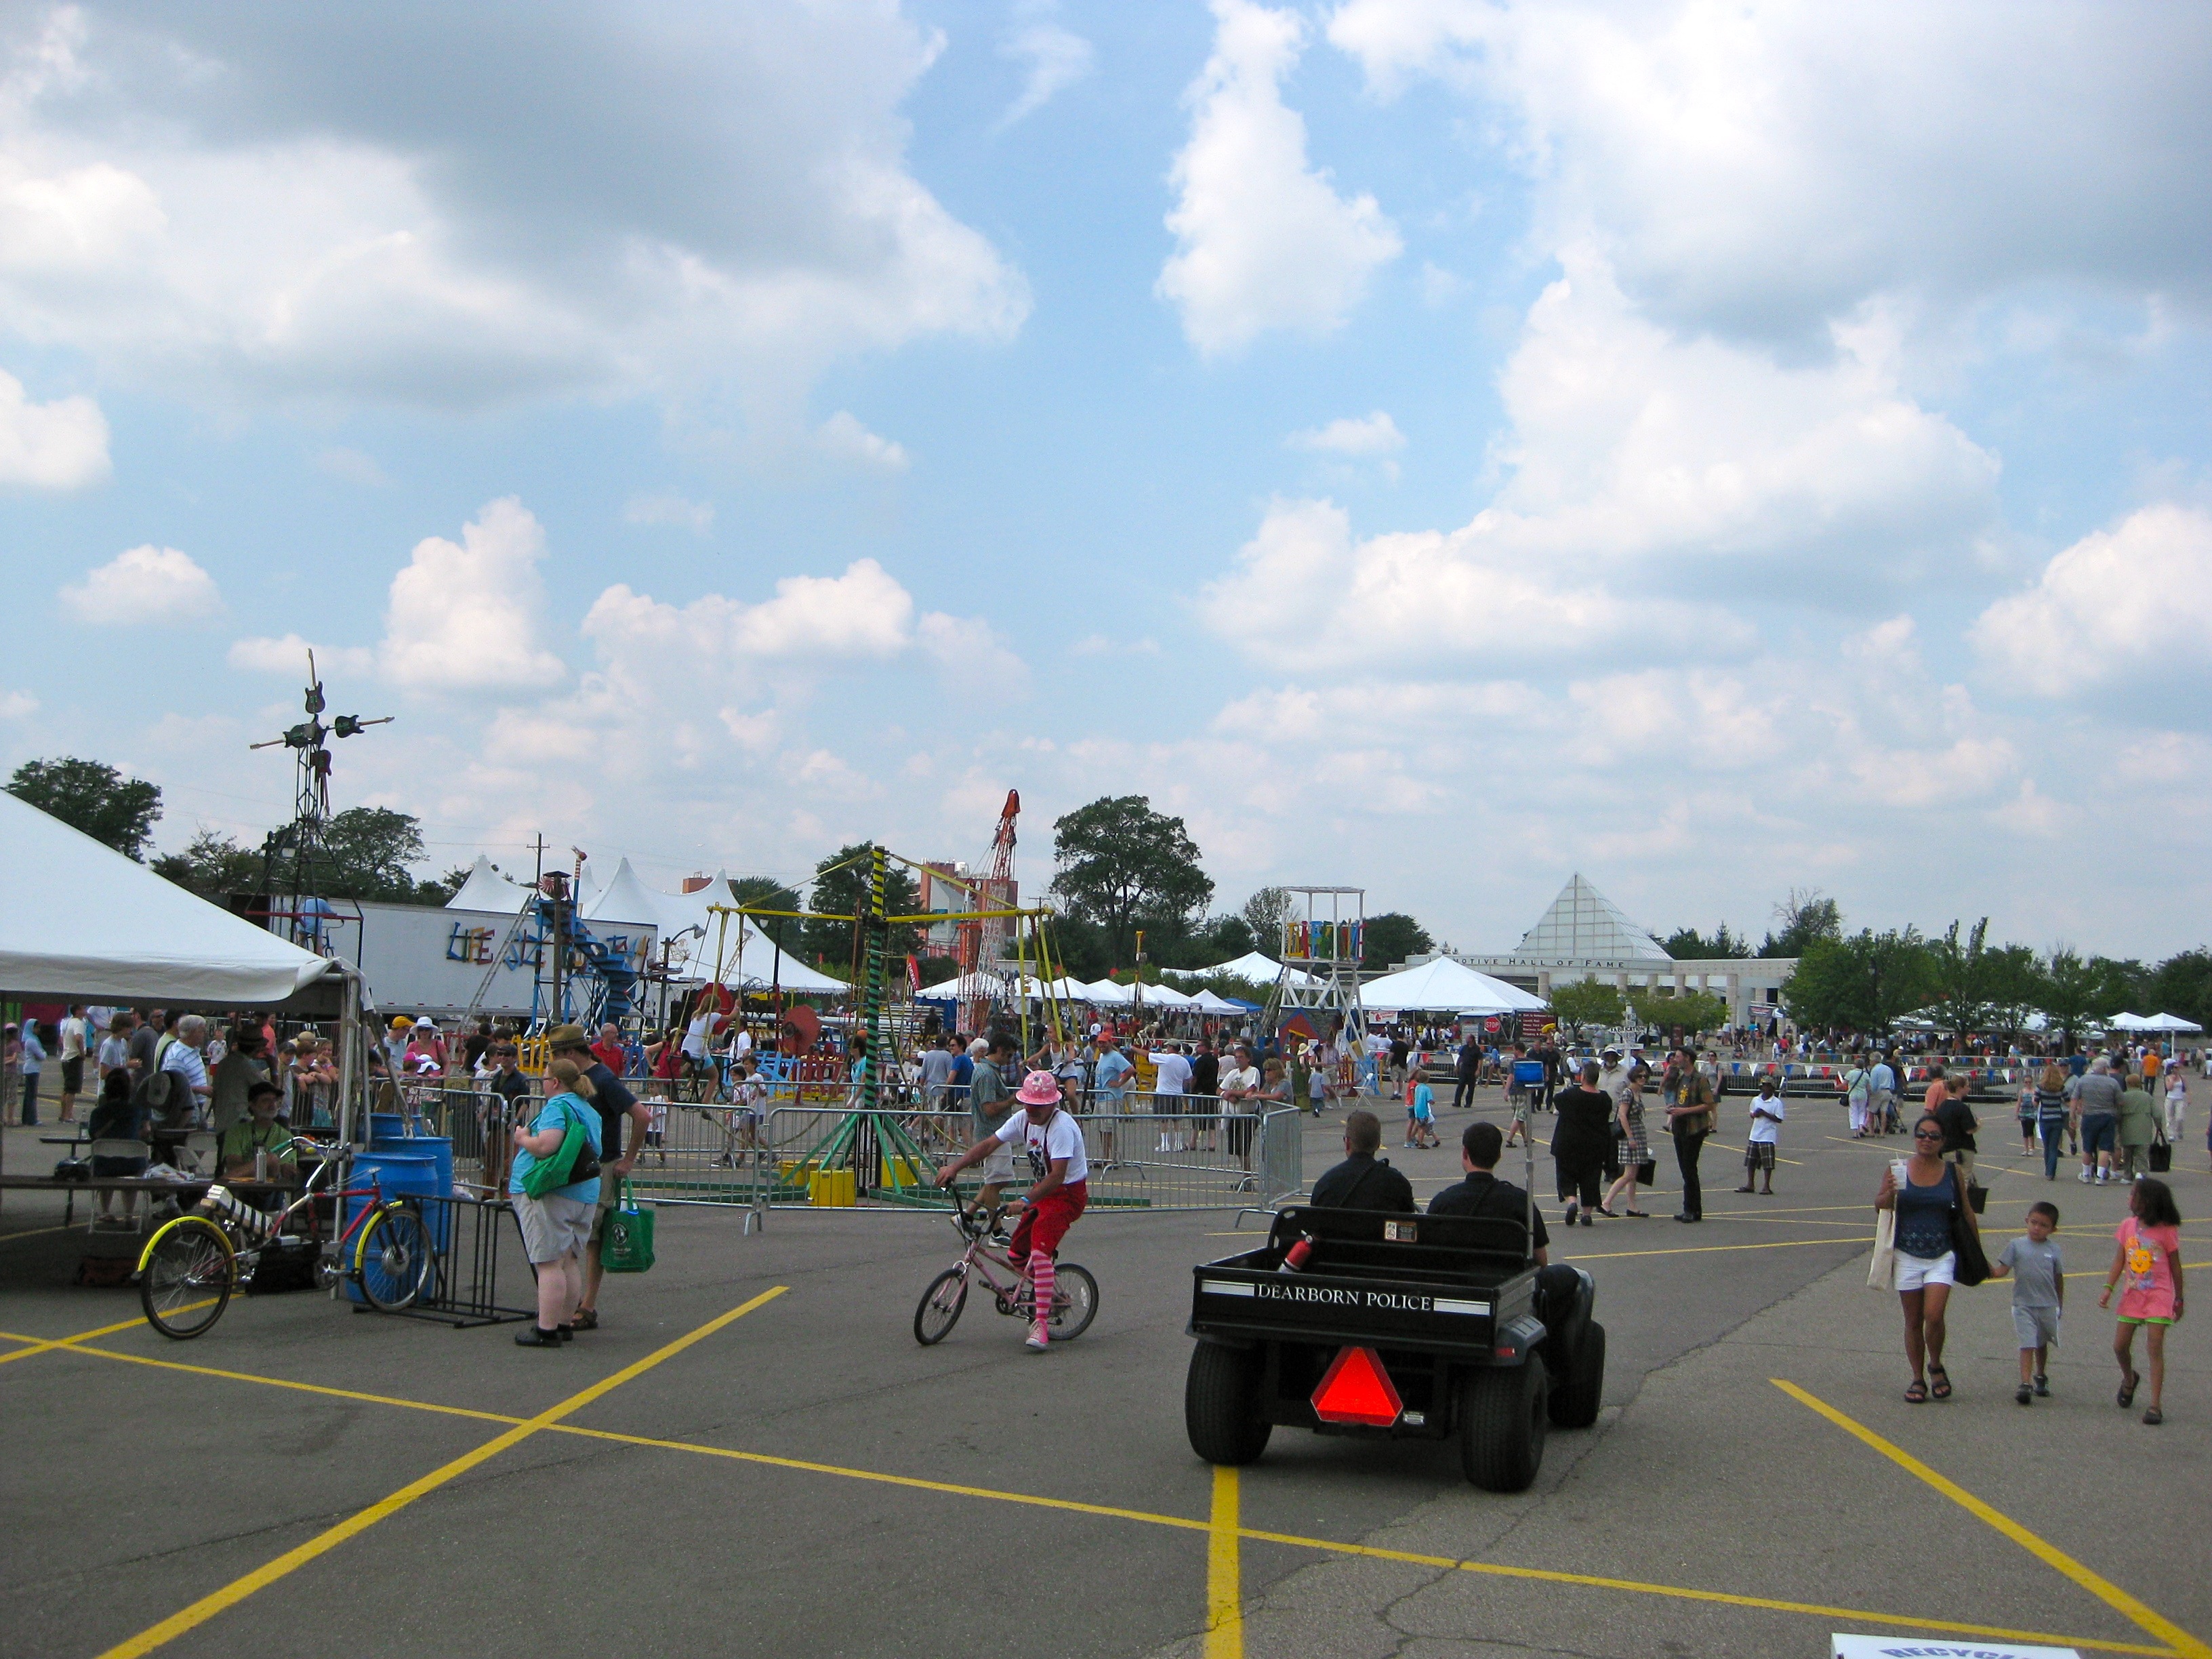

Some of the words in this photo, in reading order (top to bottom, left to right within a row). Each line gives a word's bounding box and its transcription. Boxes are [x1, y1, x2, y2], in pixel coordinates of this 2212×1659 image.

[1509, 958, 1545, 966] HALL
[1585, 960, 1624, 968] FAME
[1258, 1284, 1359, 1305] DEARBORN
[1366, 1293, 1431, 1311] POLICE
